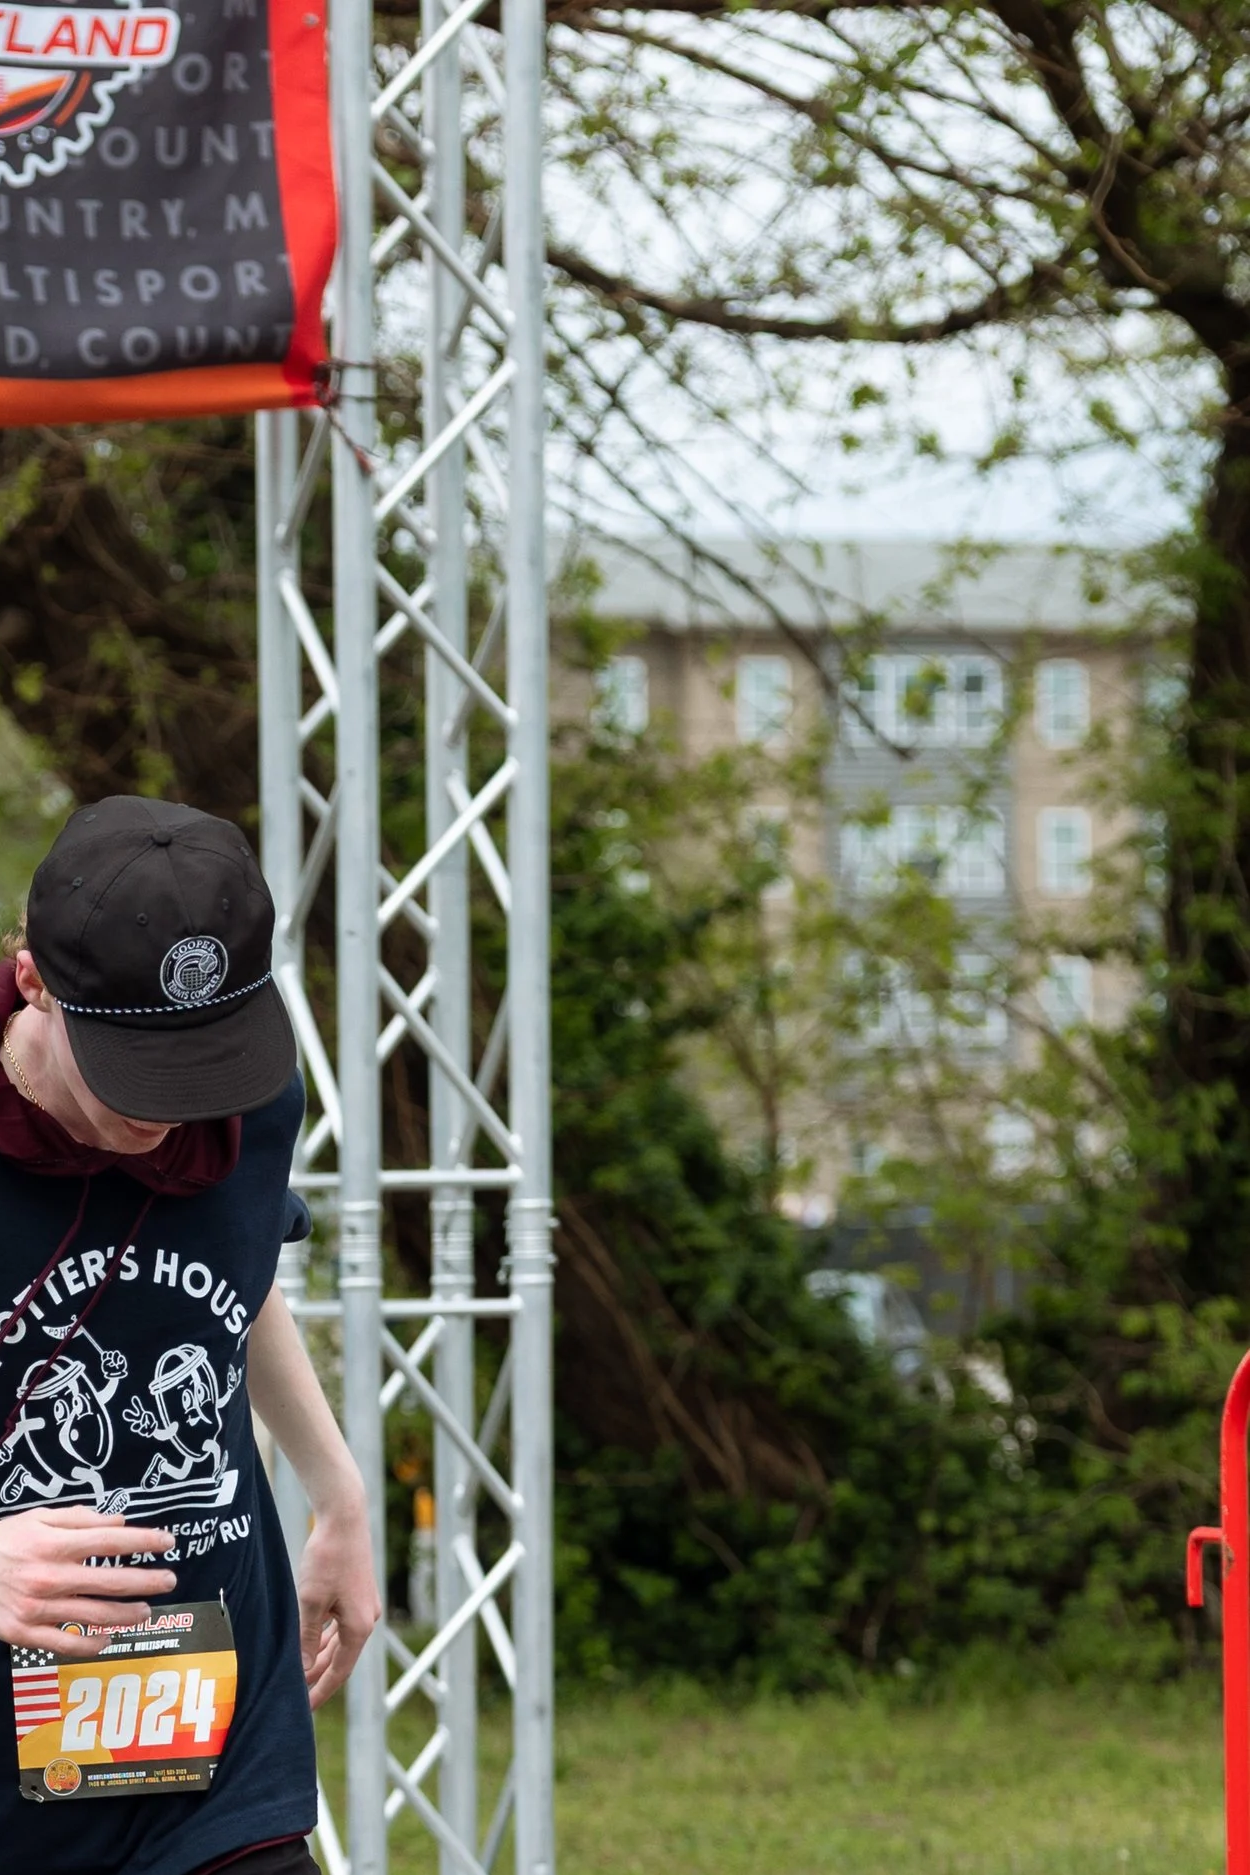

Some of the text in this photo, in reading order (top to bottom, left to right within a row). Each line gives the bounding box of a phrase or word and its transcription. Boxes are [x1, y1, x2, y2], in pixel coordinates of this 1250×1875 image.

[172, 940, 216, 960] COOPER
[167, 974, 221, 1000] TENNIS COMPLEX
[153, 1249, 252, 1351] HOUS
[186, 1531, 218, 1559] FUN
[219, 1513, 252, 1544] RU
[60, 1668, 216, 1752] 2024
